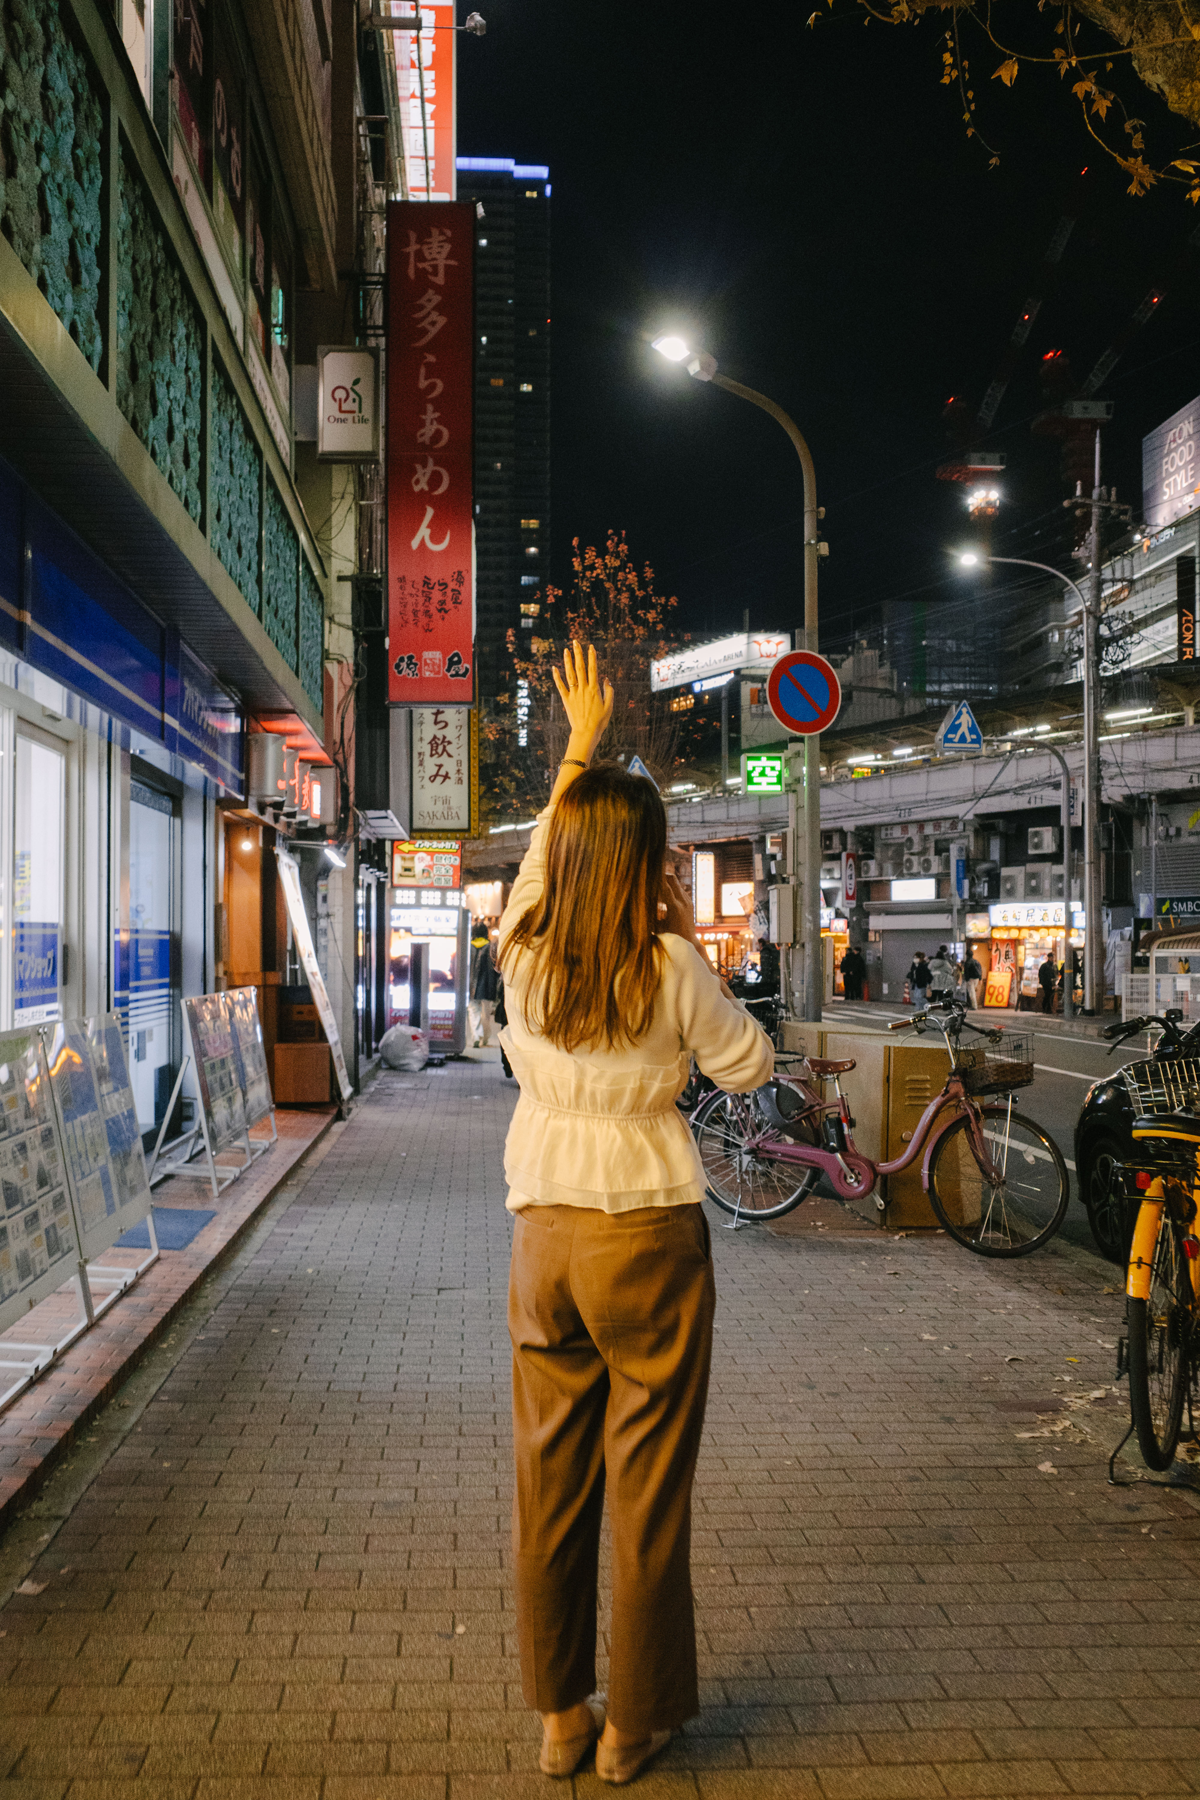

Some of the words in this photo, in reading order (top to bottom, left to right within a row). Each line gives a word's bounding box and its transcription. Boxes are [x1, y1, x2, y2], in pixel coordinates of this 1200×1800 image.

[400, 226, 459, 552] 博多らあめん
[327, 414, 348, 424] One
[352, 414, 370, 424] Life
[1162, 440, 1195, 477] FOOD
[1162, 462, 1195, 500] STYLE
[747, 756, 781, 791] 空
[418, 810, 460, 821] SAKABA
